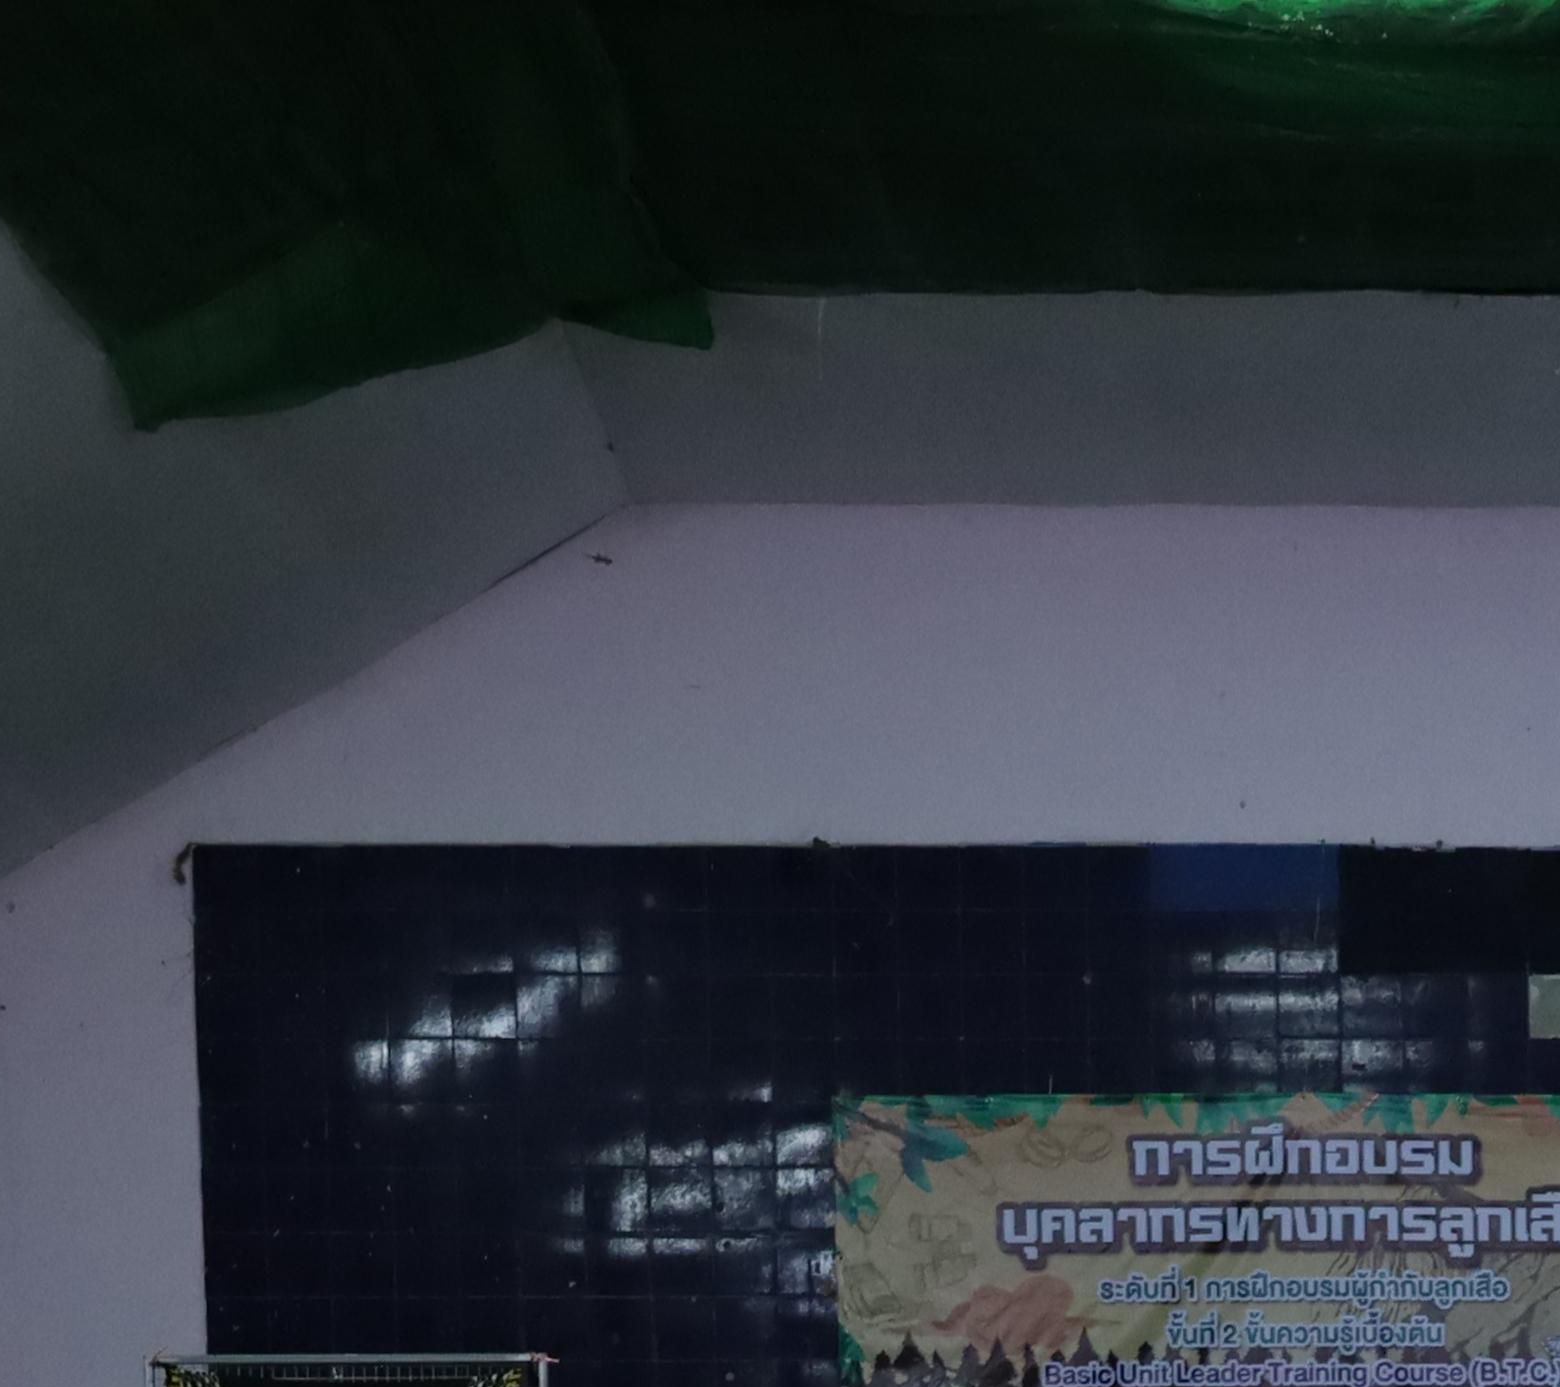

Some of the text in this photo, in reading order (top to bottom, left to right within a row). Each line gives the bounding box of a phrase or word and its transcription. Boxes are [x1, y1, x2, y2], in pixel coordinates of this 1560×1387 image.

[1130, 1119, 1476, 1179] การฝึกอบรม
[1098, 1266, 1510, 1307] ระดับที่ 1 การฝึกอบรมผู้กำกับลูกเสือ
[1167, 1309, 1444, 1353] ขั้นที่ 2 ขั้นความรู้เบื้องต้น
[1043, 1362, 1114, 1387] Basic
[1117, 1361, 1171, 1386] Unit
[1174, 1361, 1262, 1386] Leader
[1374, 1360, 1465, 1384] Course
